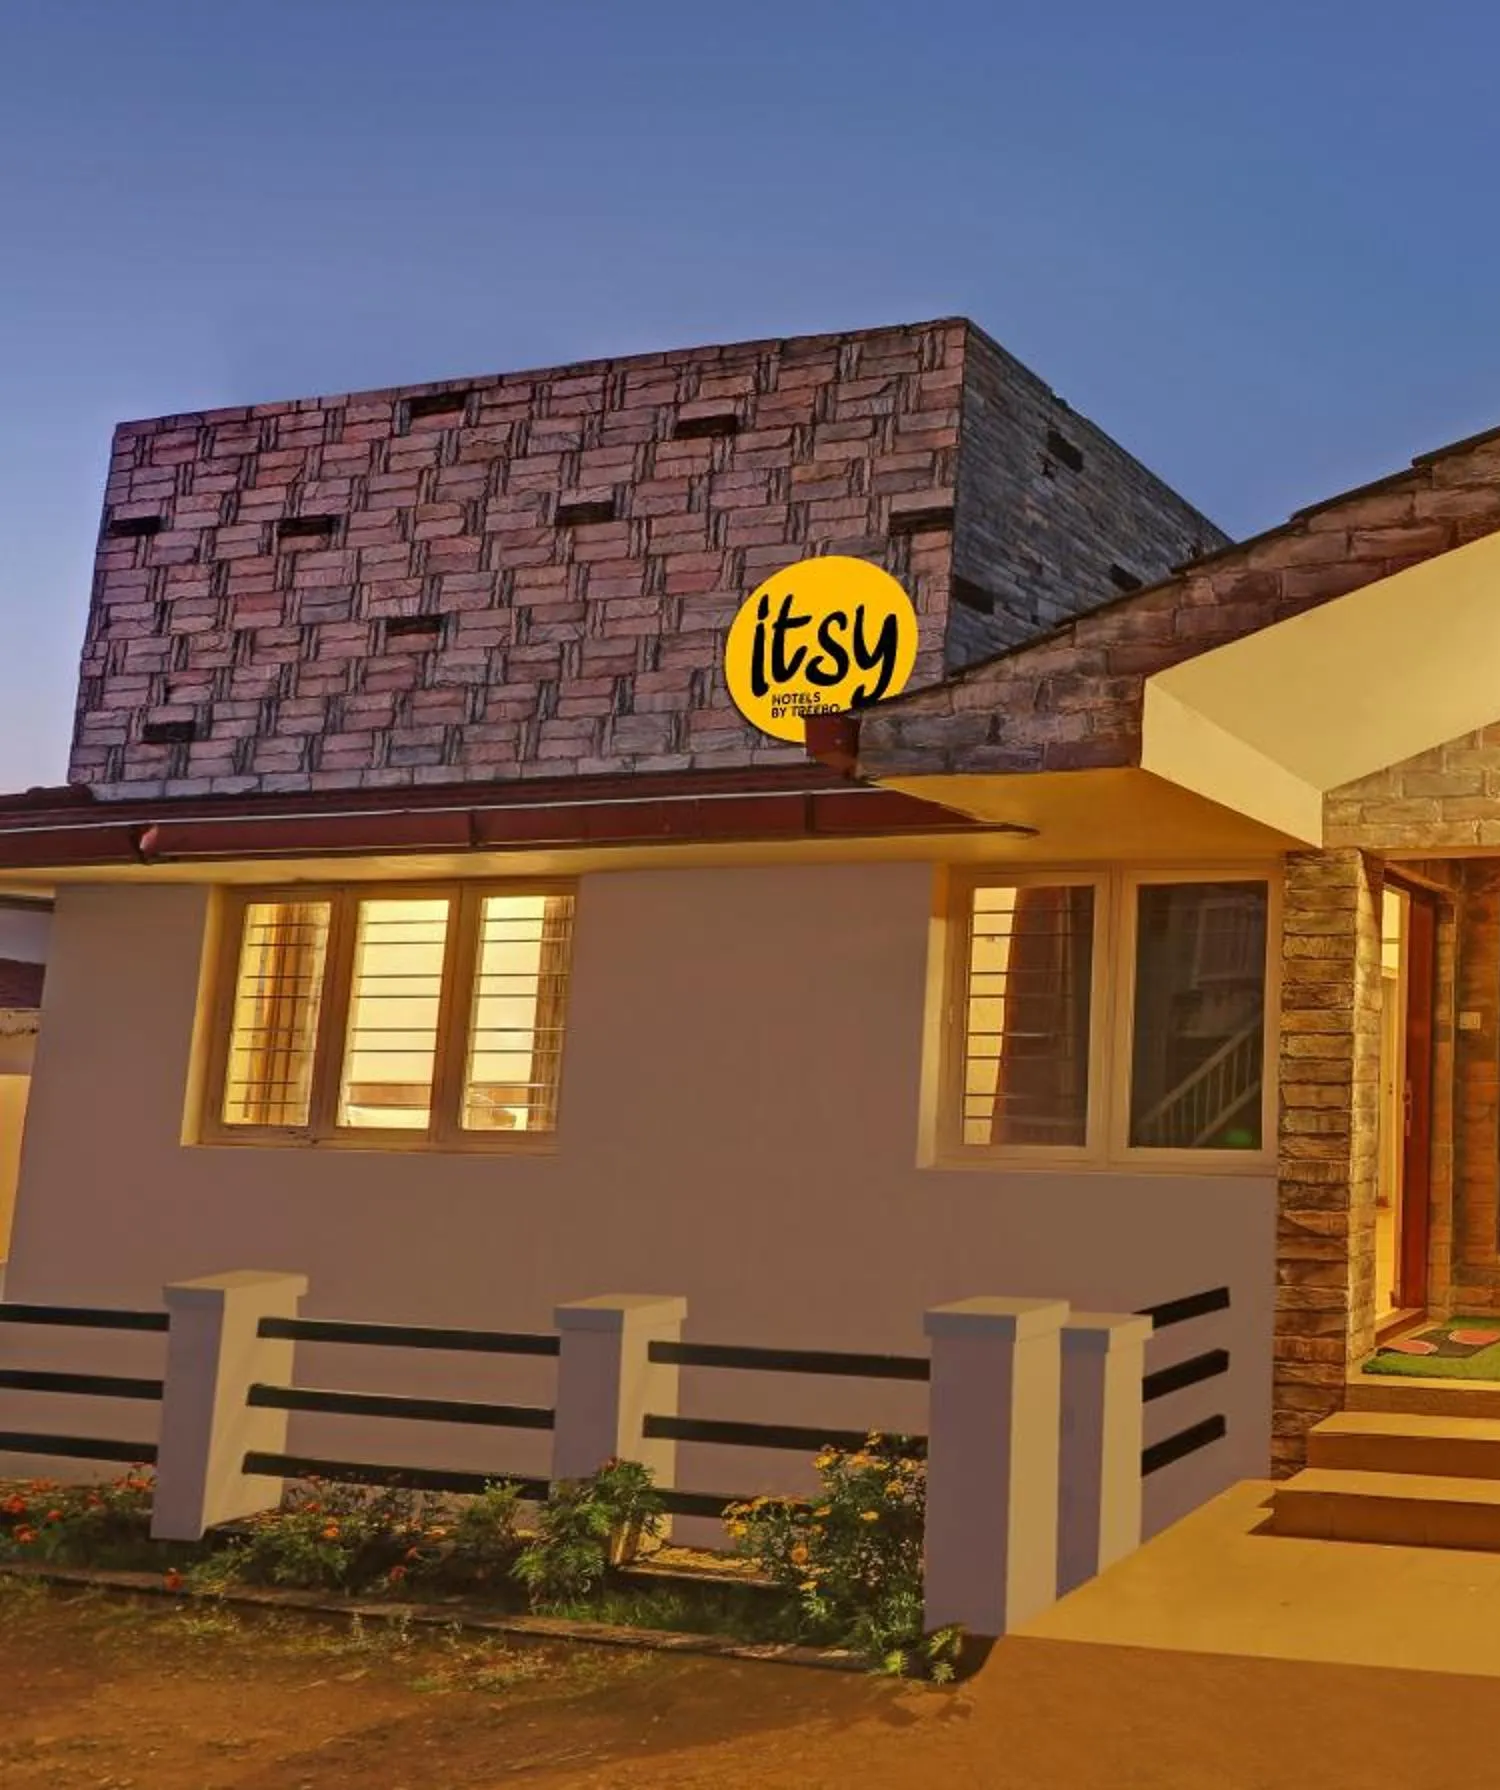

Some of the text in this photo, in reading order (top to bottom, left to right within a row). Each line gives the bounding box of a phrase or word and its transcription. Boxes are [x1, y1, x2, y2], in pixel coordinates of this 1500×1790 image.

[752, 594, 898, 708] itsy
[771, 692, 821, 706] HOTELS
[771, 707, 787, 719] BY
